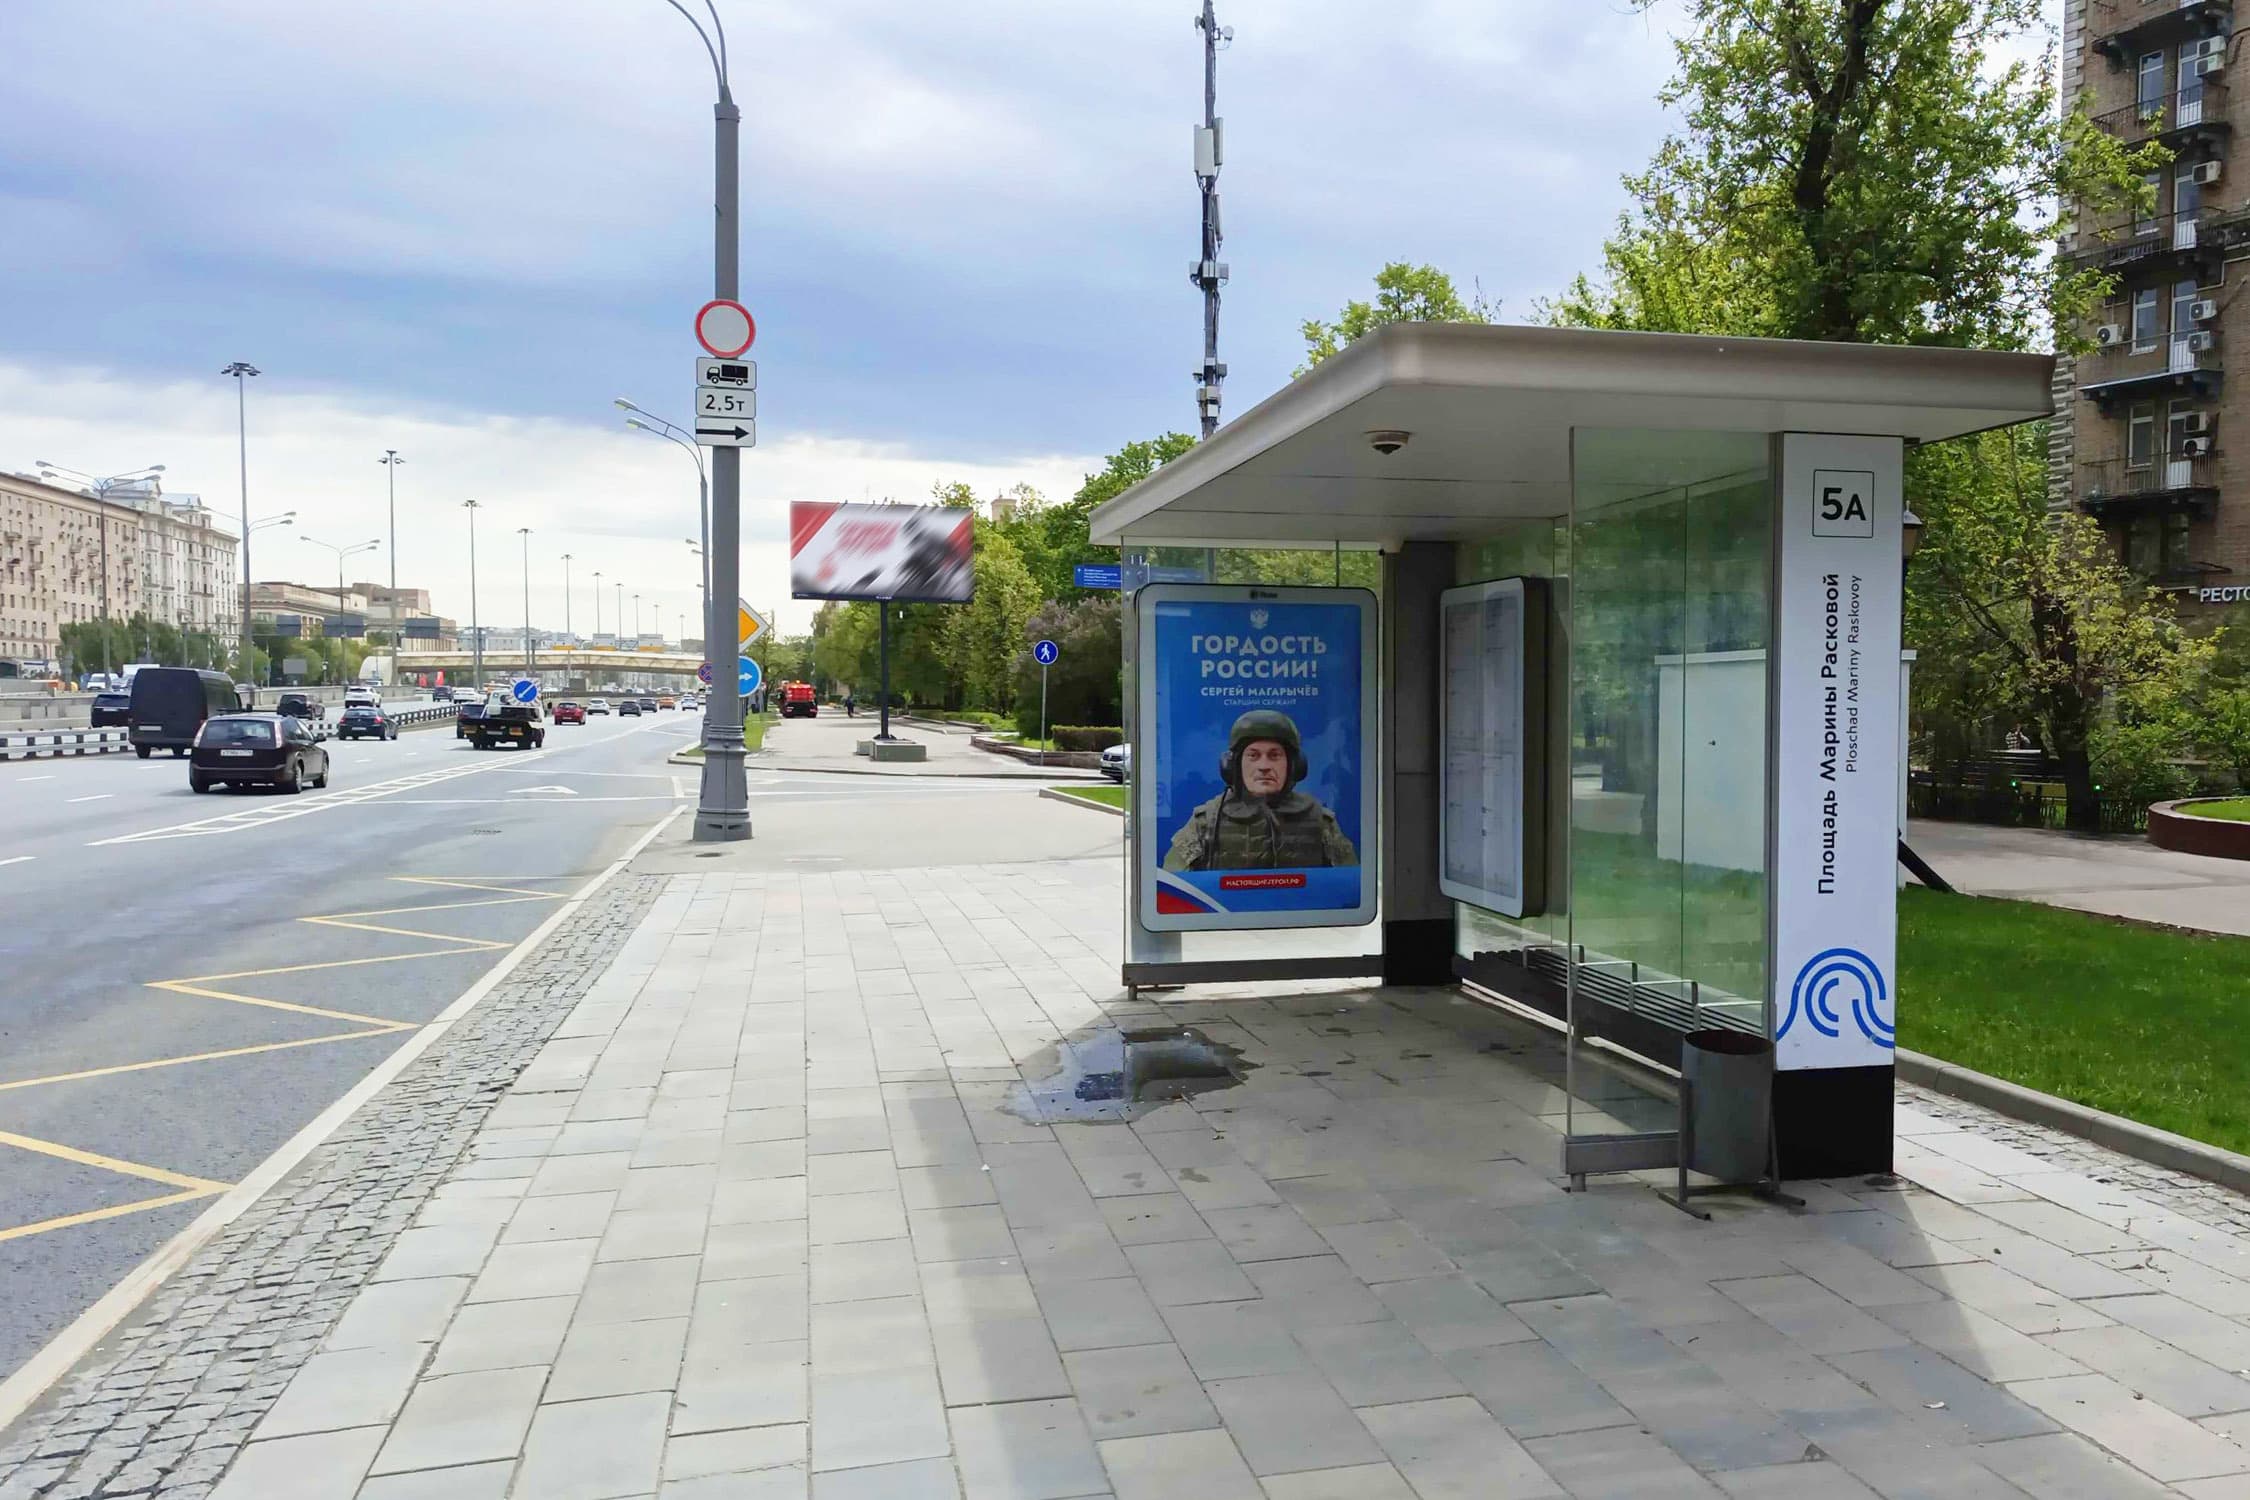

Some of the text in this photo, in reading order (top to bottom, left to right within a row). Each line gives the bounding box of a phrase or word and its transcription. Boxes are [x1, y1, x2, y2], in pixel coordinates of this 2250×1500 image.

[1191, 635, 1327, 656] ГОРДОСТЬ
[1201, 659, 1317, 679] РОССИИ!
[1845, 575, 1862, 773] Ploschad Mariny Raskovoy
[1200, 684, 1244, 697] СЕРГЕЙ
[1818, 574, 1840, 894] Площадь Марины Расковой
